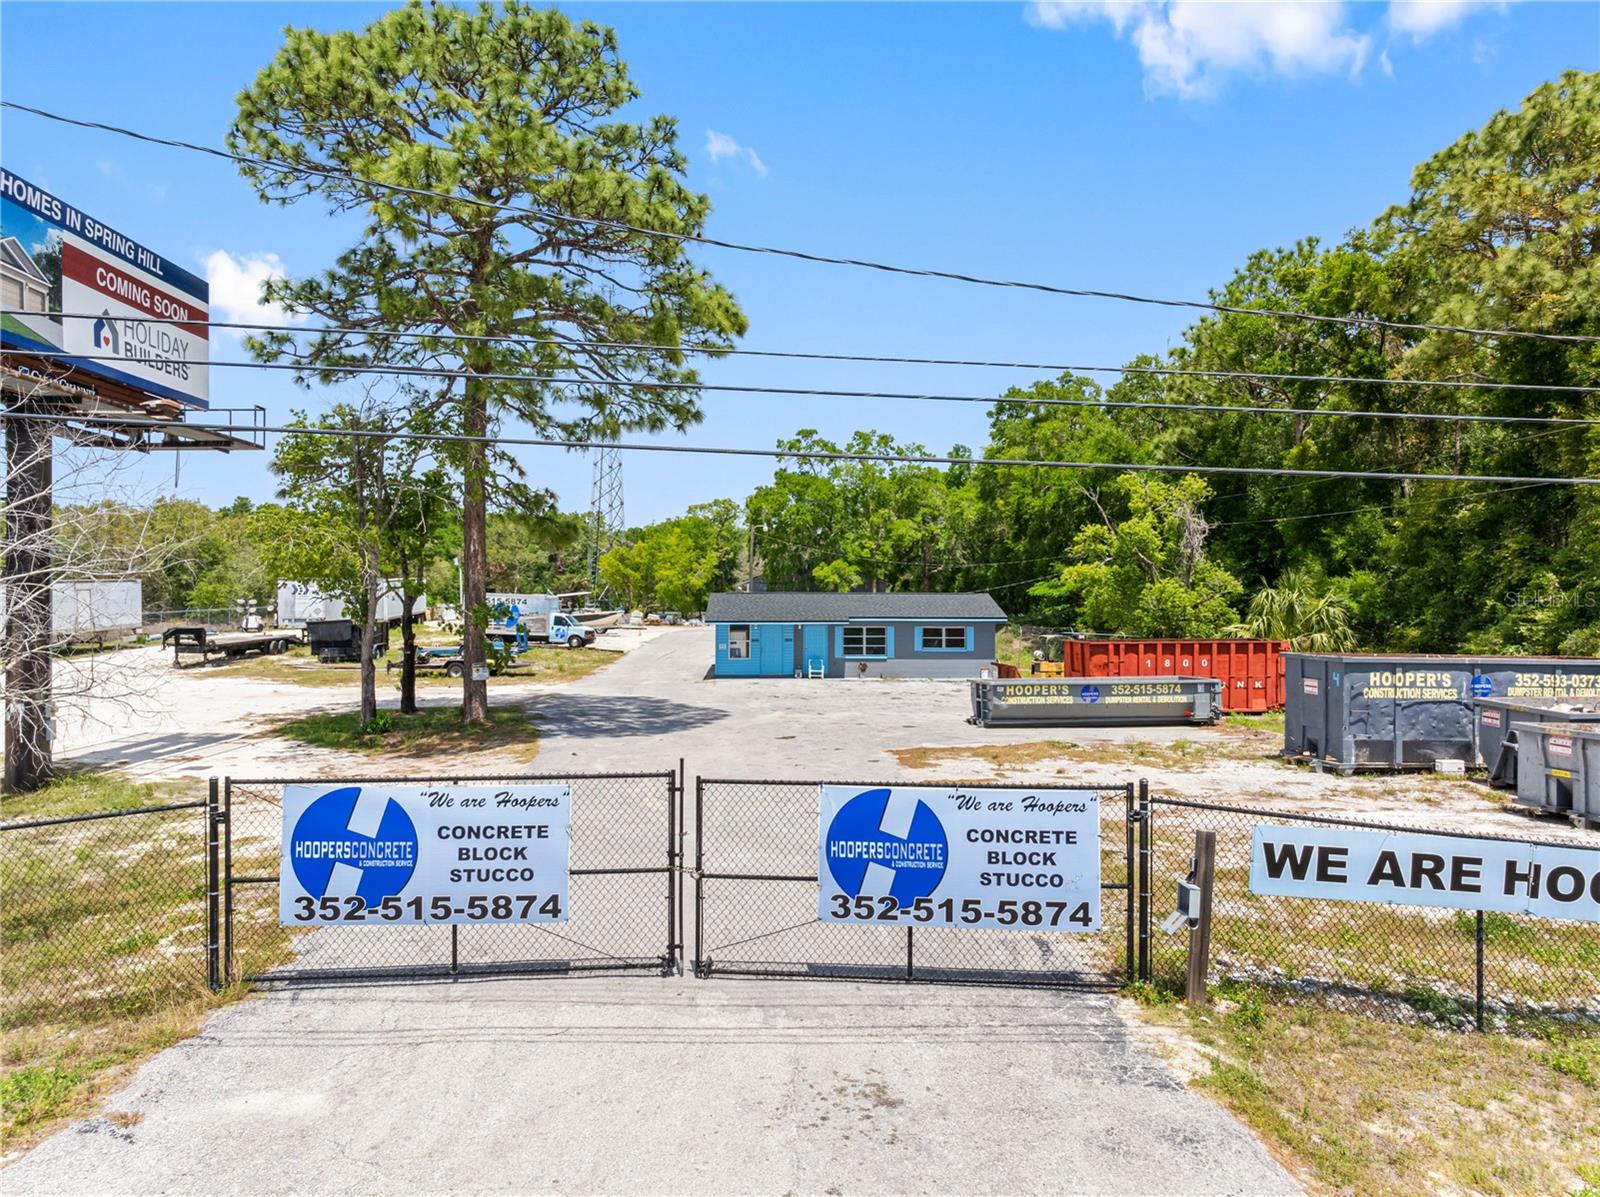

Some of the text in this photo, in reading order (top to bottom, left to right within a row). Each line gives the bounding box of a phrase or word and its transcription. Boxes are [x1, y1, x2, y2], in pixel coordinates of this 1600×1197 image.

[0, 171, 164, 275] HOMES IN SPRING HILL
[96, 267, 189, 321] COMING SOON
[124, 318, 189, 360] HOLIDAY
[124, 341, 189, 381] BUILDERS
[1368, 671, 1453, 687] HOOPER'S
[1005, 685, 1070, 696] HOOPER'S
[1111, 684, 1182, 695] 352-515-5874
[1363, 687, 1458, 699] CONSTRUCTION SERVICES
[1507, 687, 1542, 697] DUMPSTER
[460, 797, 487, 808] are
[987, 801, 1014, 812] are
[437, 825, 549, 839] CONCRETE
[966, 829, 1078, 844] CONCRETE
[458, 847, 528, 861] BLOCK
[987, 851, 1057, 866] BLOCK
[450, 868, 535, 883] STUCCO
[979, 872, 1064, 888] STUCCO
[1262, 841, 1600, 905] WE ARE HO
[293, 894, 562, 921] 352-515-5874
[830, 894, 1093, 927] 352-515-5874
